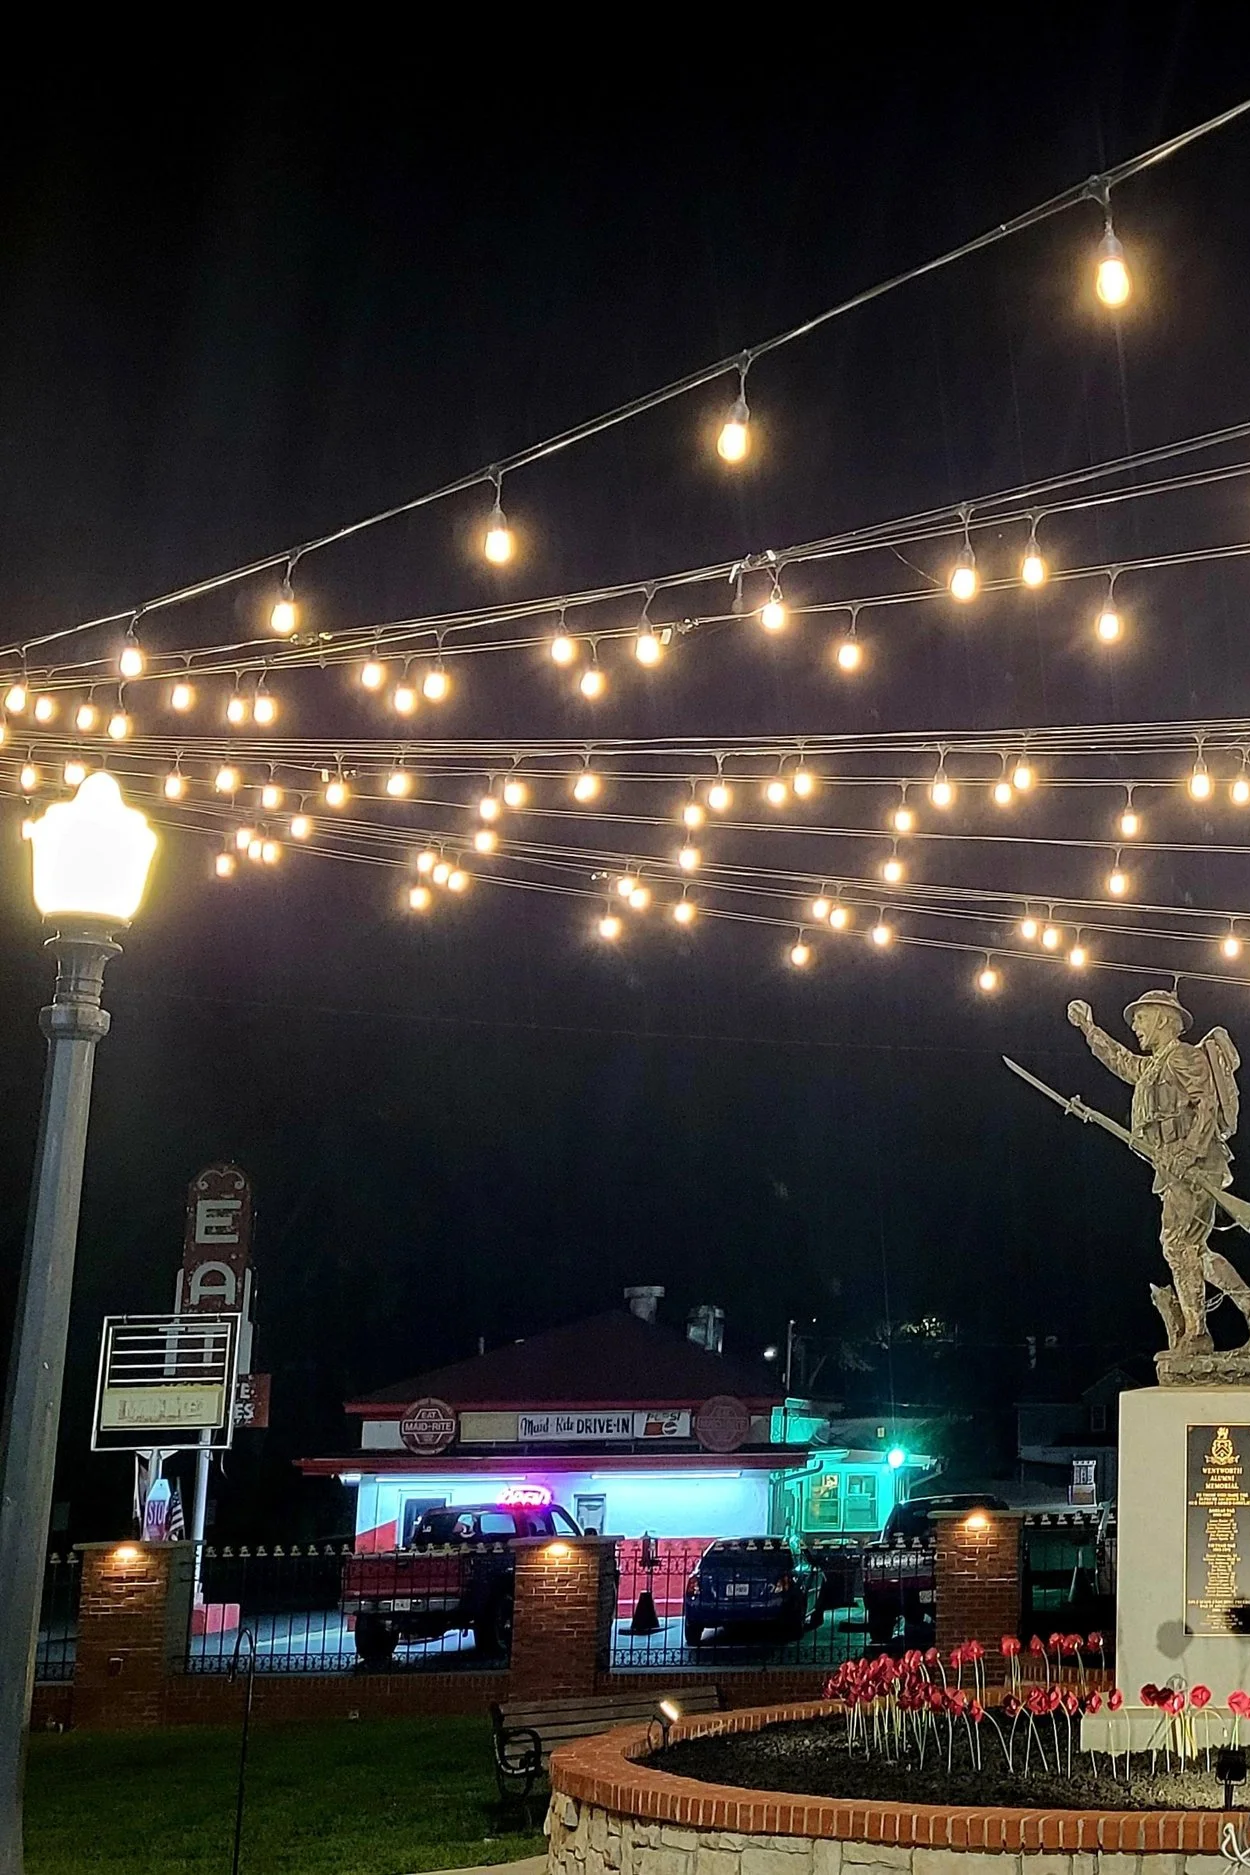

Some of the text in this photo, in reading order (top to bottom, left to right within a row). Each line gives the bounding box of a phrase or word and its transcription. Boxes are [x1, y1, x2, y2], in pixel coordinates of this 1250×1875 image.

[187, 1199, 242, 1368] EAT
[421, 1411, 437, 1419] EAT
[405, 1422, 452, 1431] MAID-RITE
[576, 1417, 630, 1434] DRIVE-IN
[147, 1501, 165, 1525] STO
